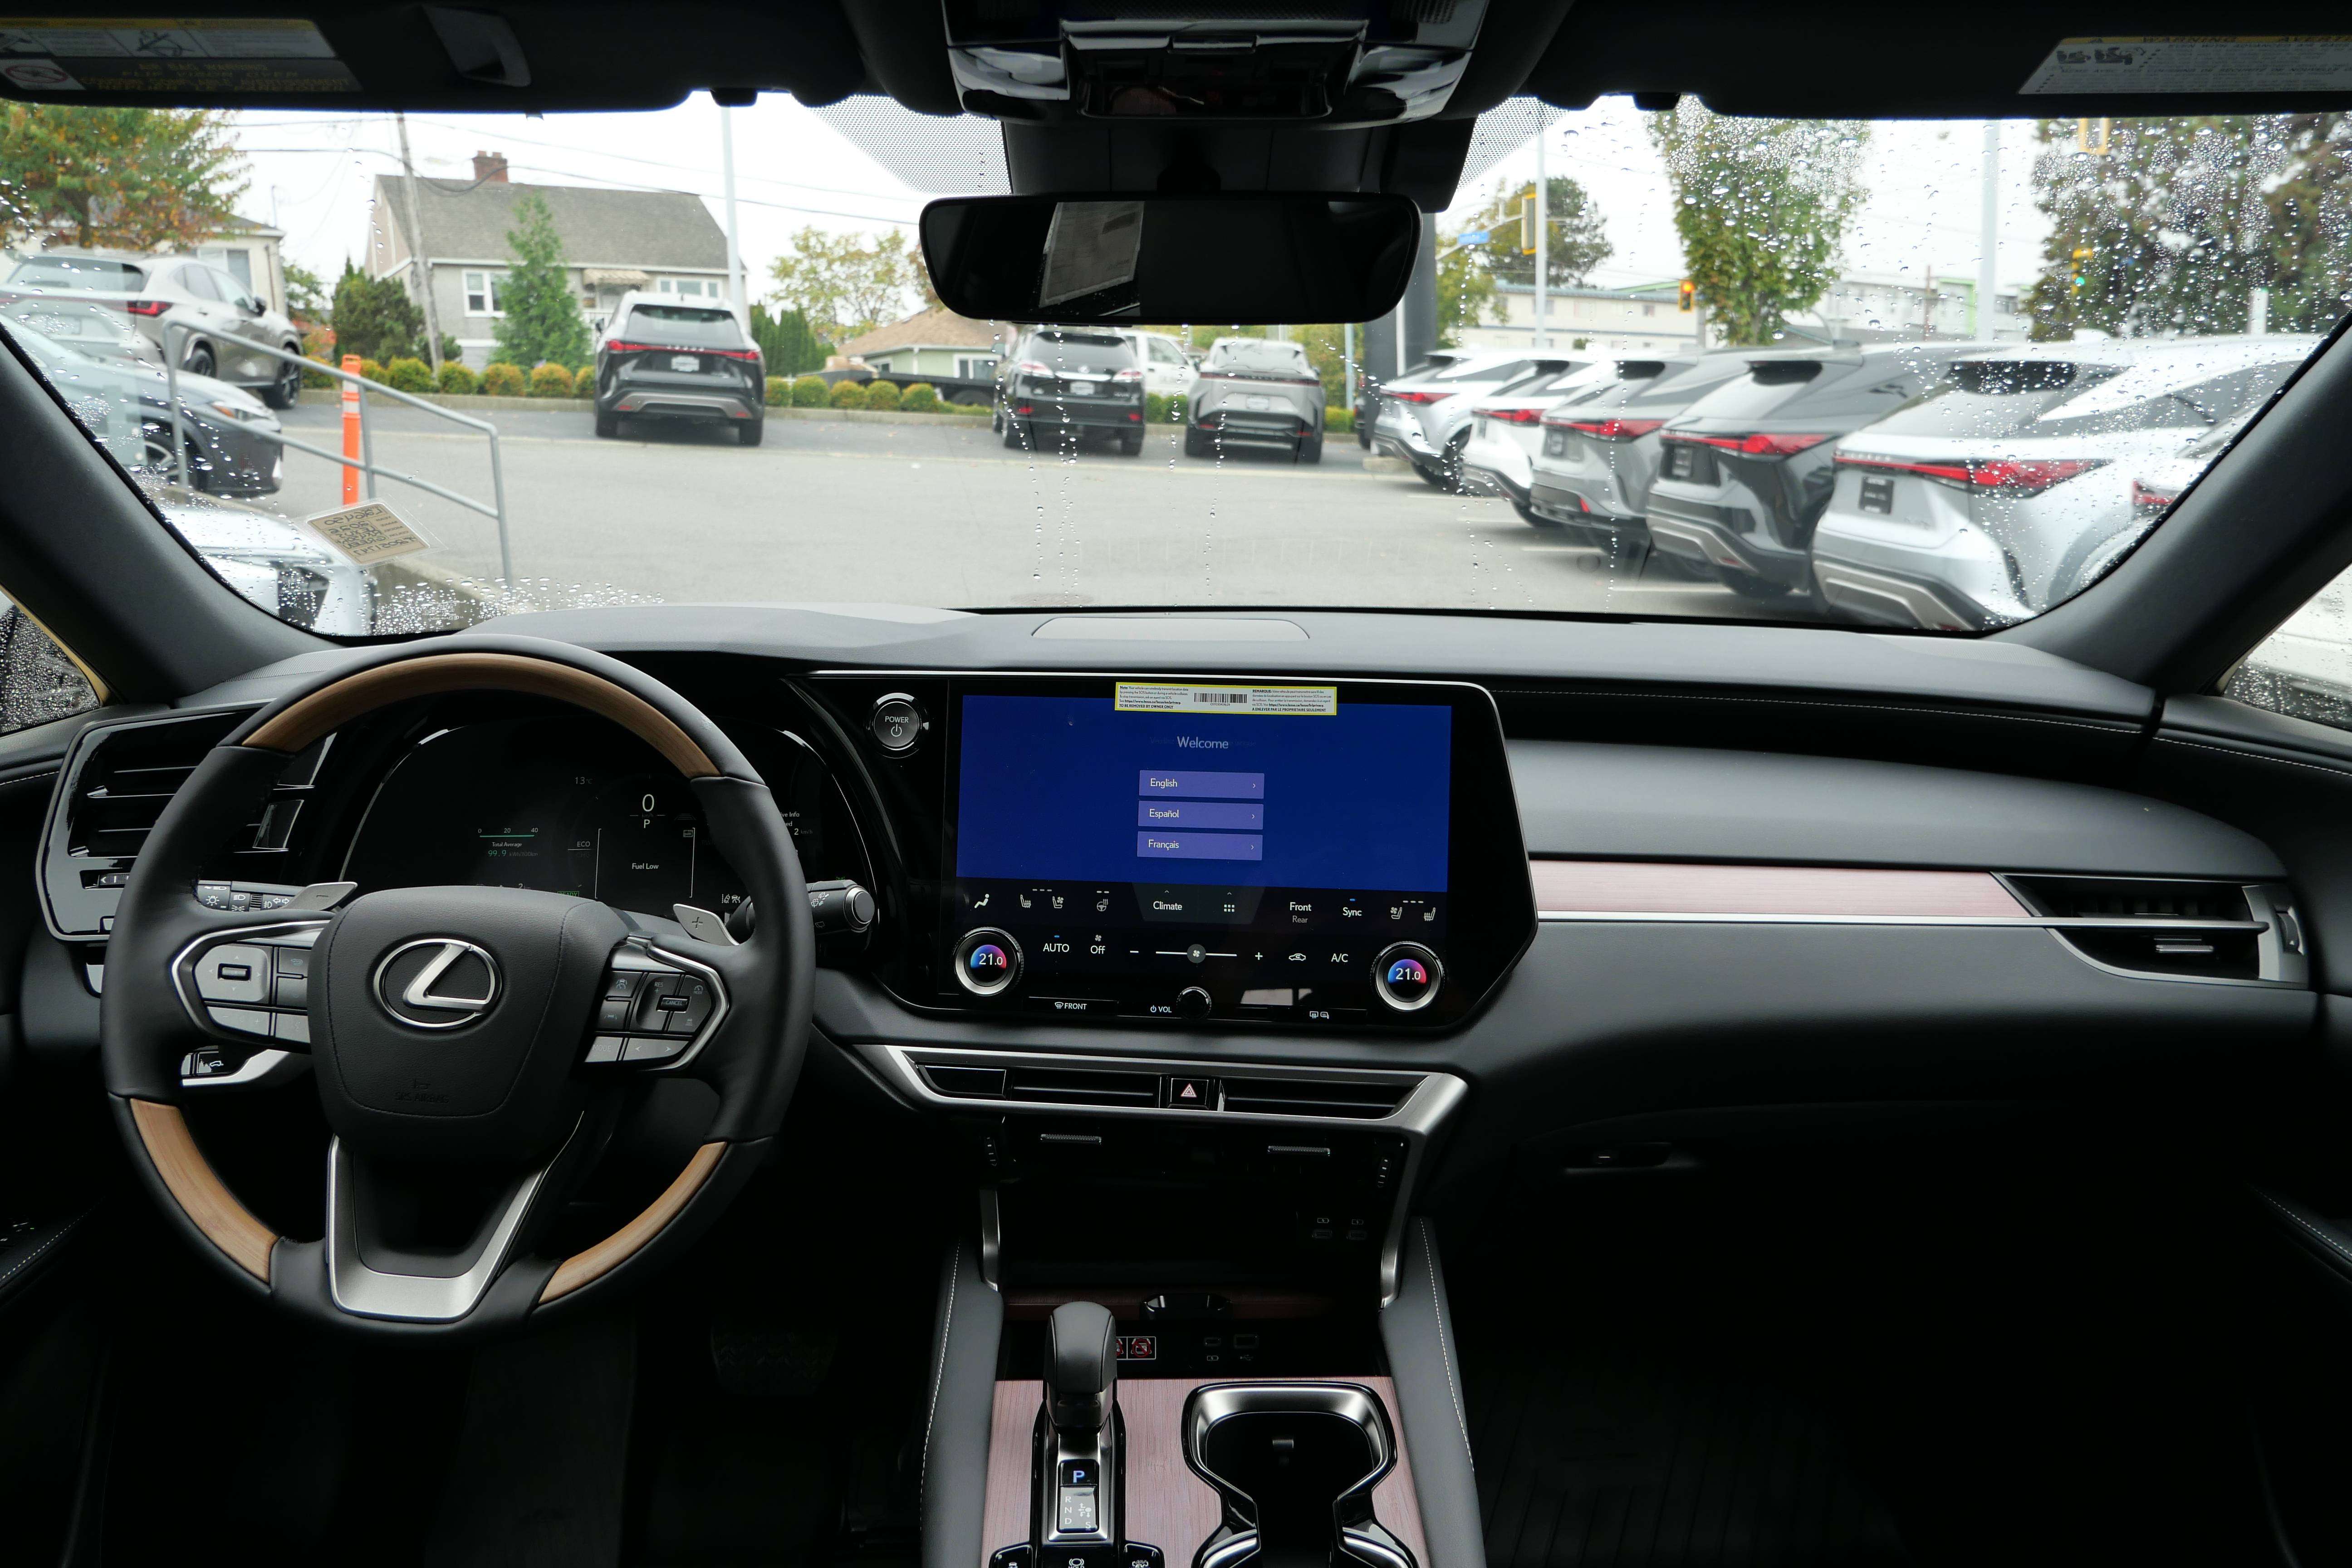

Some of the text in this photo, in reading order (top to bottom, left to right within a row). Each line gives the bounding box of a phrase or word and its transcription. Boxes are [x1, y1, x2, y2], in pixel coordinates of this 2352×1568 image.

[1176, 735, 1229, 749] Welcome
[1150, 778, 1177, 789] English
[642, 794, 655, 812] 0
[1149, 808, 1179, 819] Español
[644, 819, 650, 828] P
[1148, 839, 1179, 851] Français
[1153, 901, 1182, 911] Climate
[1290, 902, 1312, 911] Front
[1343, 907, 1362, 917] Sync
[1292, 915, 1308, 923] Rear
[1043, 943, 1069, 952] AUTO
[1090, 945, 1106, 954] Off
[979, 953, 1003, 965] 21.0
[1331, 953, 1348, 962] A/C
[1396, 968, 1421, 980] 21.0
[1073, 1470, 1084, 1483] P
